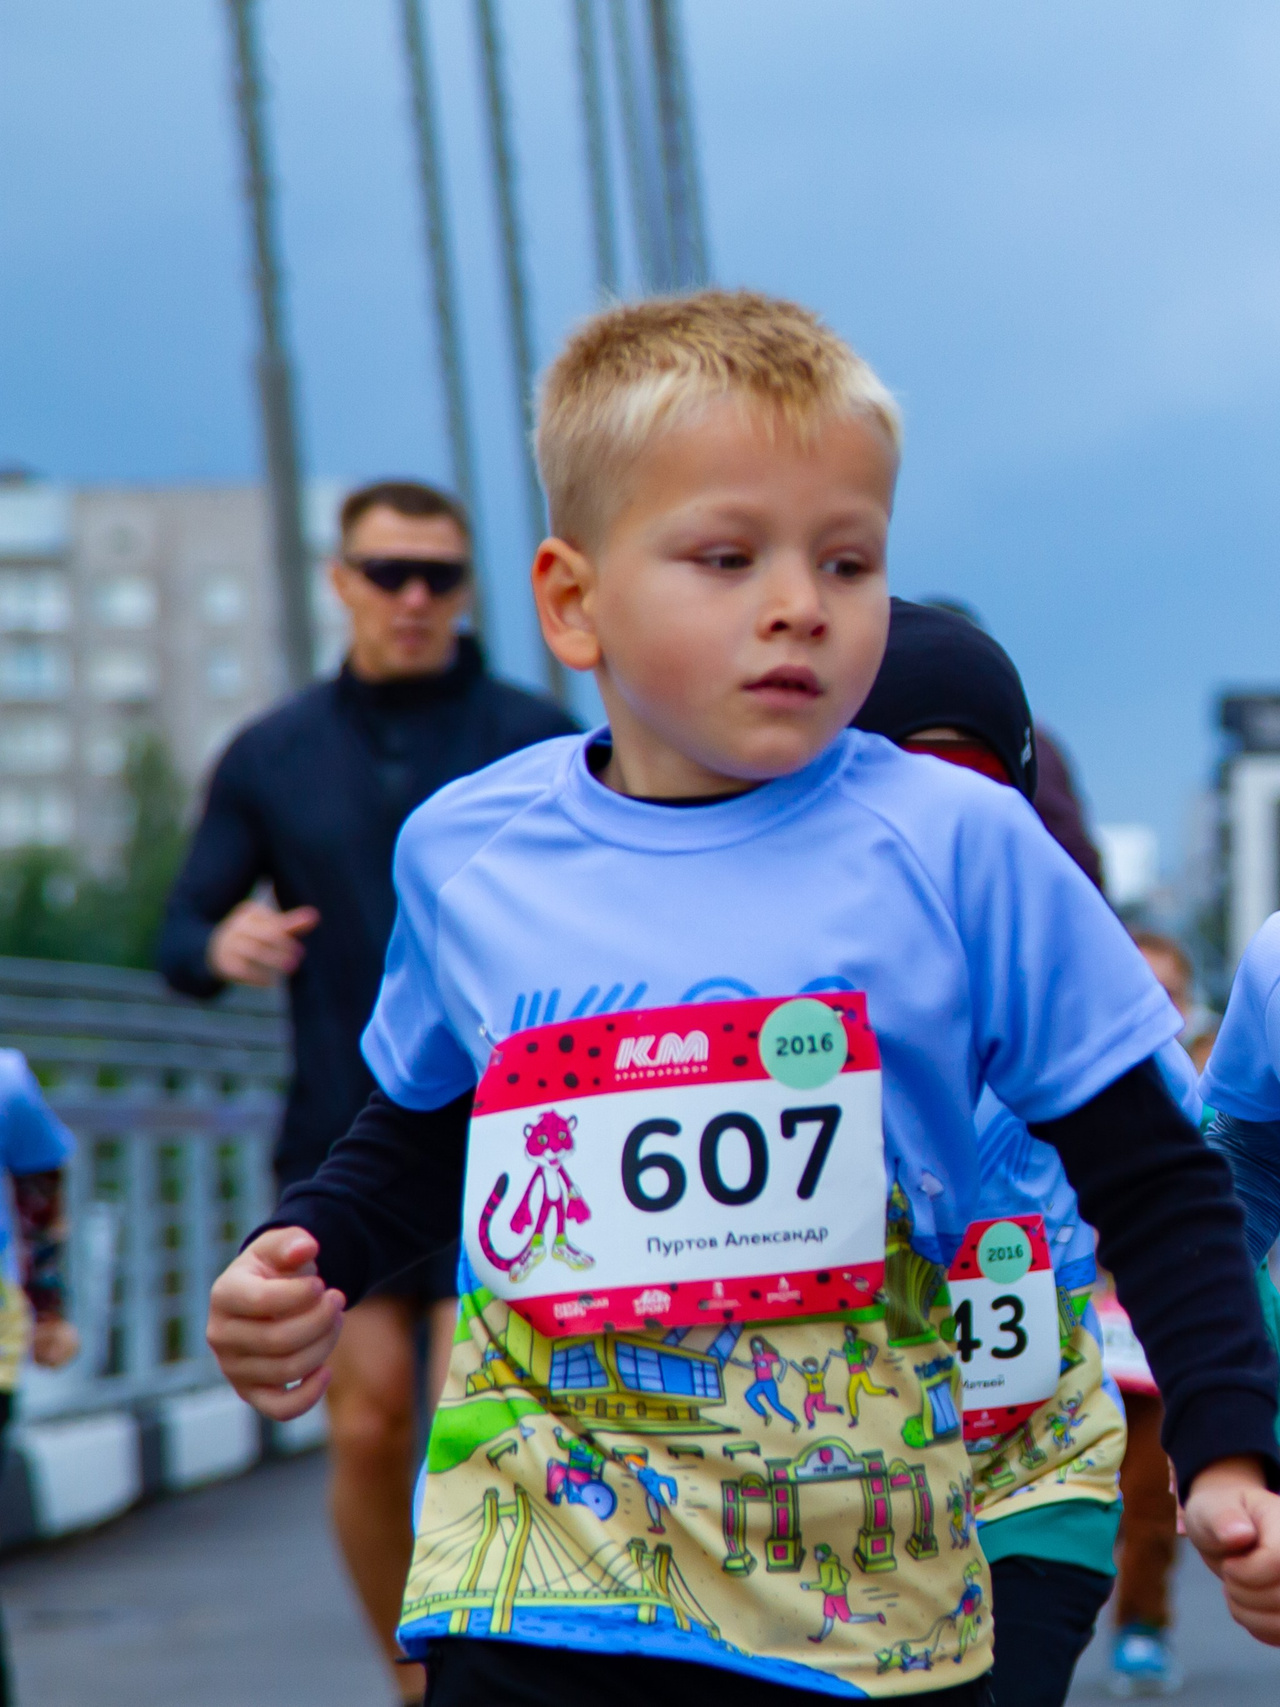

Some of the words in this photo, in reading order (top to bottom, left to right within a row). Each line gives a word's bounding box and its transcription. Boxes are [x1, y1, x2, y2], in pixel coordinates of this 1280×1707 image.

[775, 1032, 834, 1057] 2016
[620, 1104, 842, 1213] 607
[647, 1236, 718, 1257] Пуртов
[725, 1226, 829, 1247] Александр
[987, 1245, 1024, 1262] 2016
